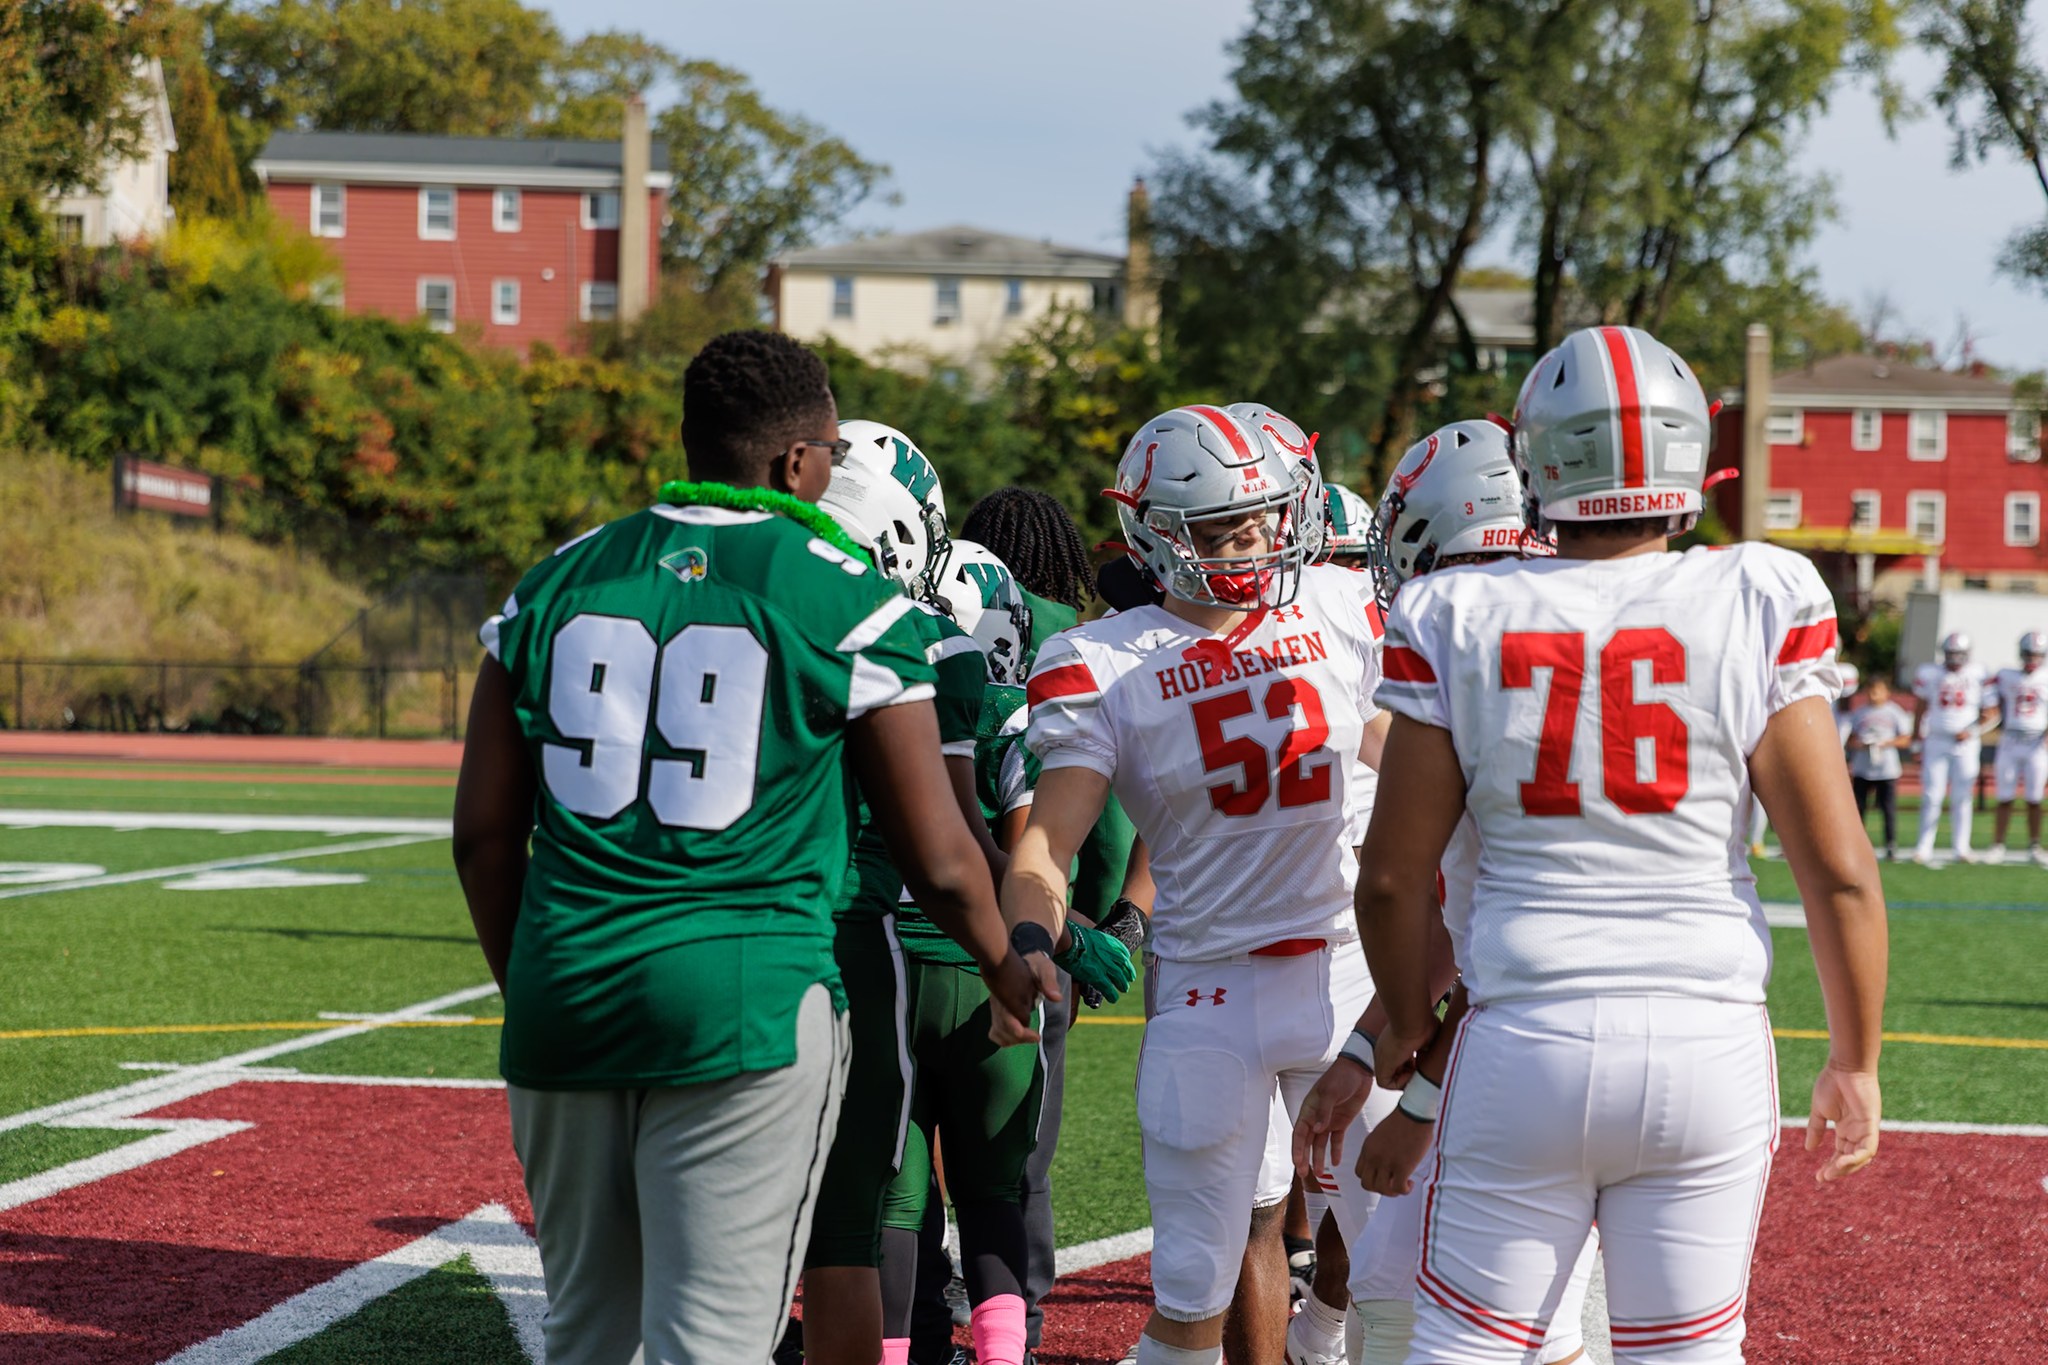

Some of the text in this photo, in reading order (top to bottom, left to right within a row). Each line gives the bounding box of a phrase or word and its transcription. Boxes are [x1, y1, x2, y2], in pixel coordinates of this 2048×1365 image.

[890, 436, 938, 507] W
[1544, 465, 1560, 480] 76
[1578, 492, 1686, 516] HORSEMEN
[1465, 502, 1474, 516] 3
[541, 612, 769, 830] 99
[1188, 675, 1329, 818] 52
[1500, 625, 1692, 818] 76
